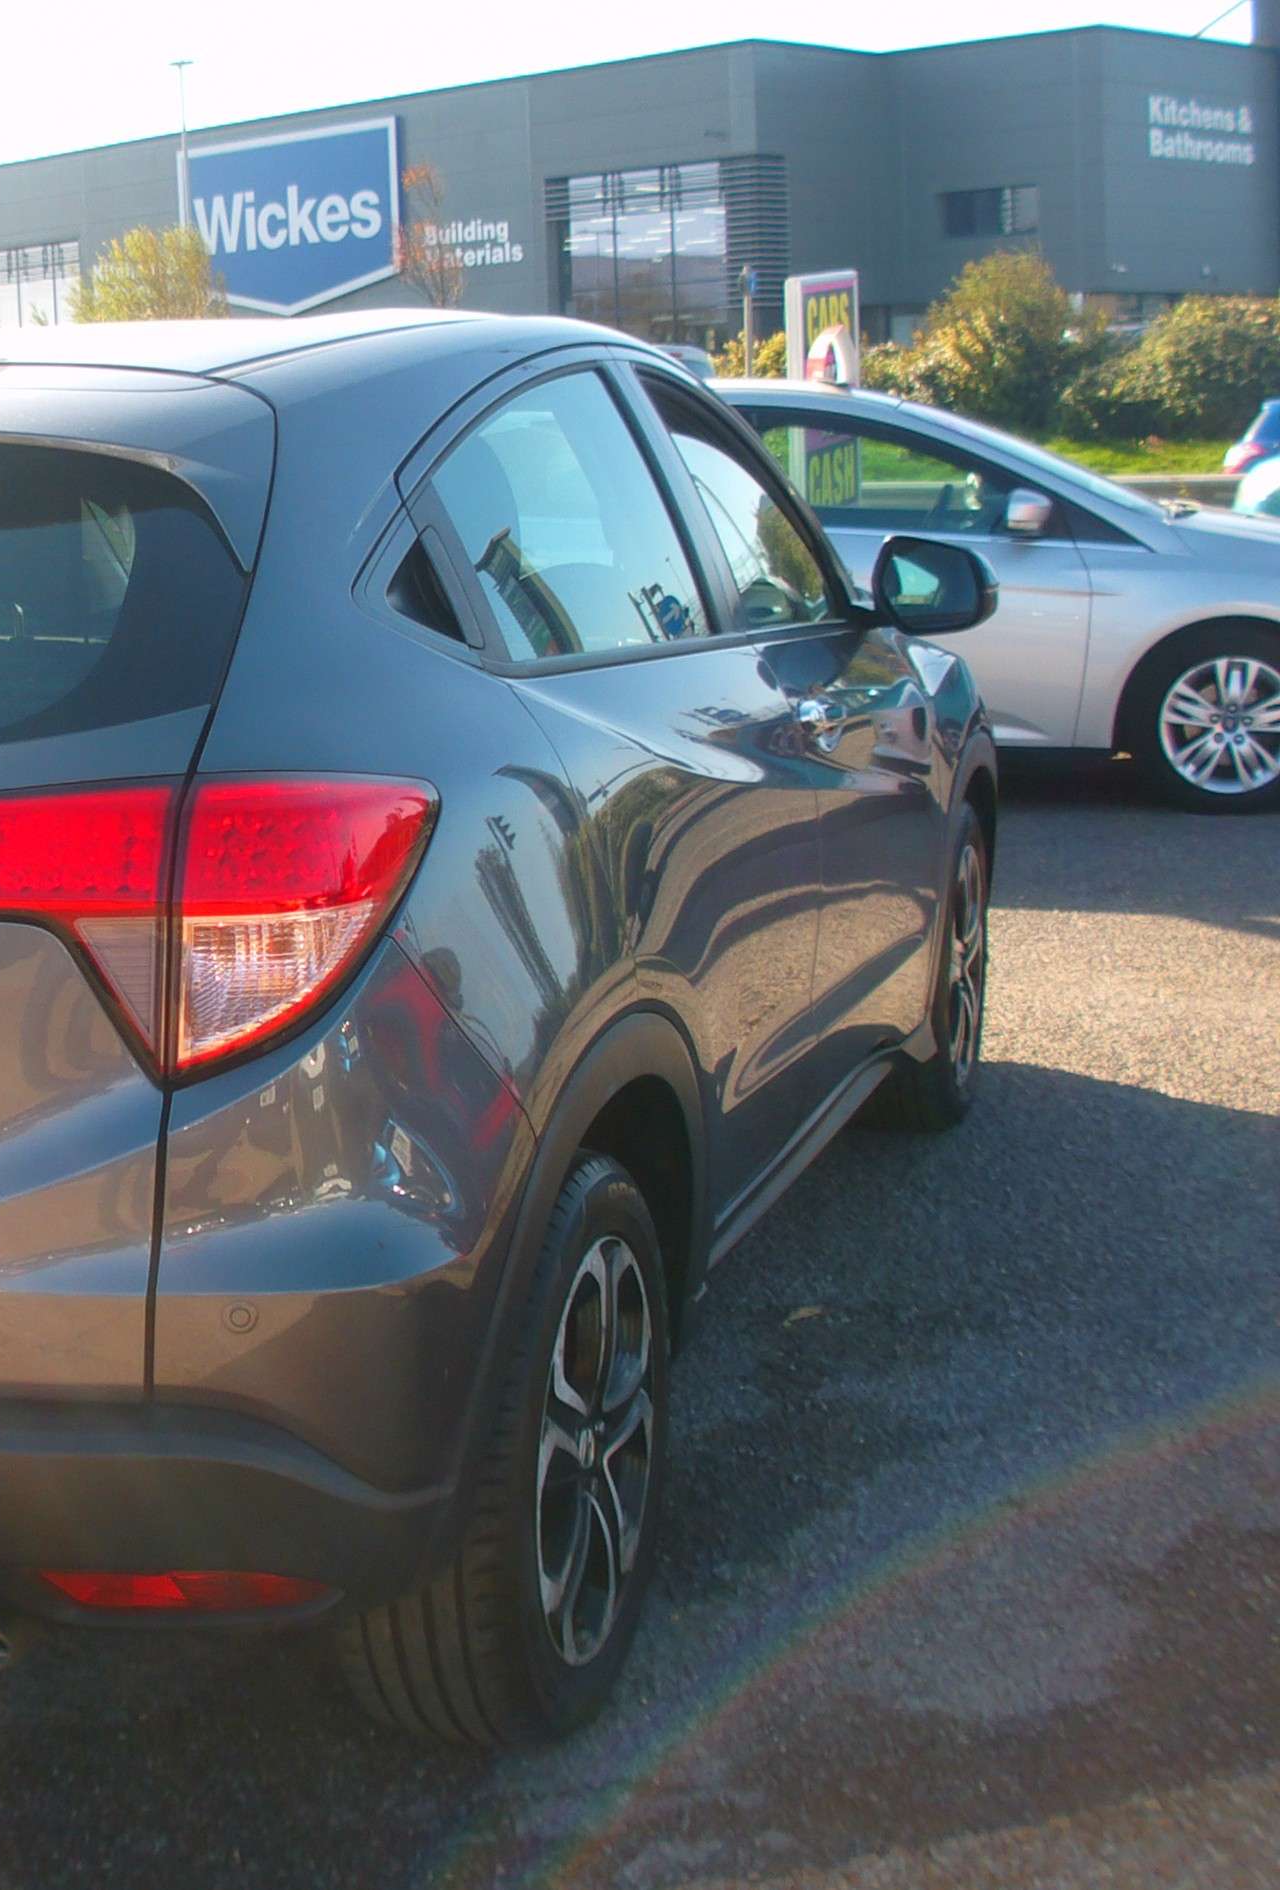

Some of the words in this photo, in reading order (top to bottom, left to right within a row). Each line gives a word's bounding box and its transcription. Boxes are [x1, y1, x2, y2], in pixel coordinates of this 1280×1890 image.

[1149, 96, 1234, 132] Kitchens
[1238, 104, 1252, 134] &
[1149, 128, 1254, 165] Bathrooms
[193, 183, 382, 256] Wickes
[424, 218, 509, 246] Building
[808, 444, 855, 505] CASH
